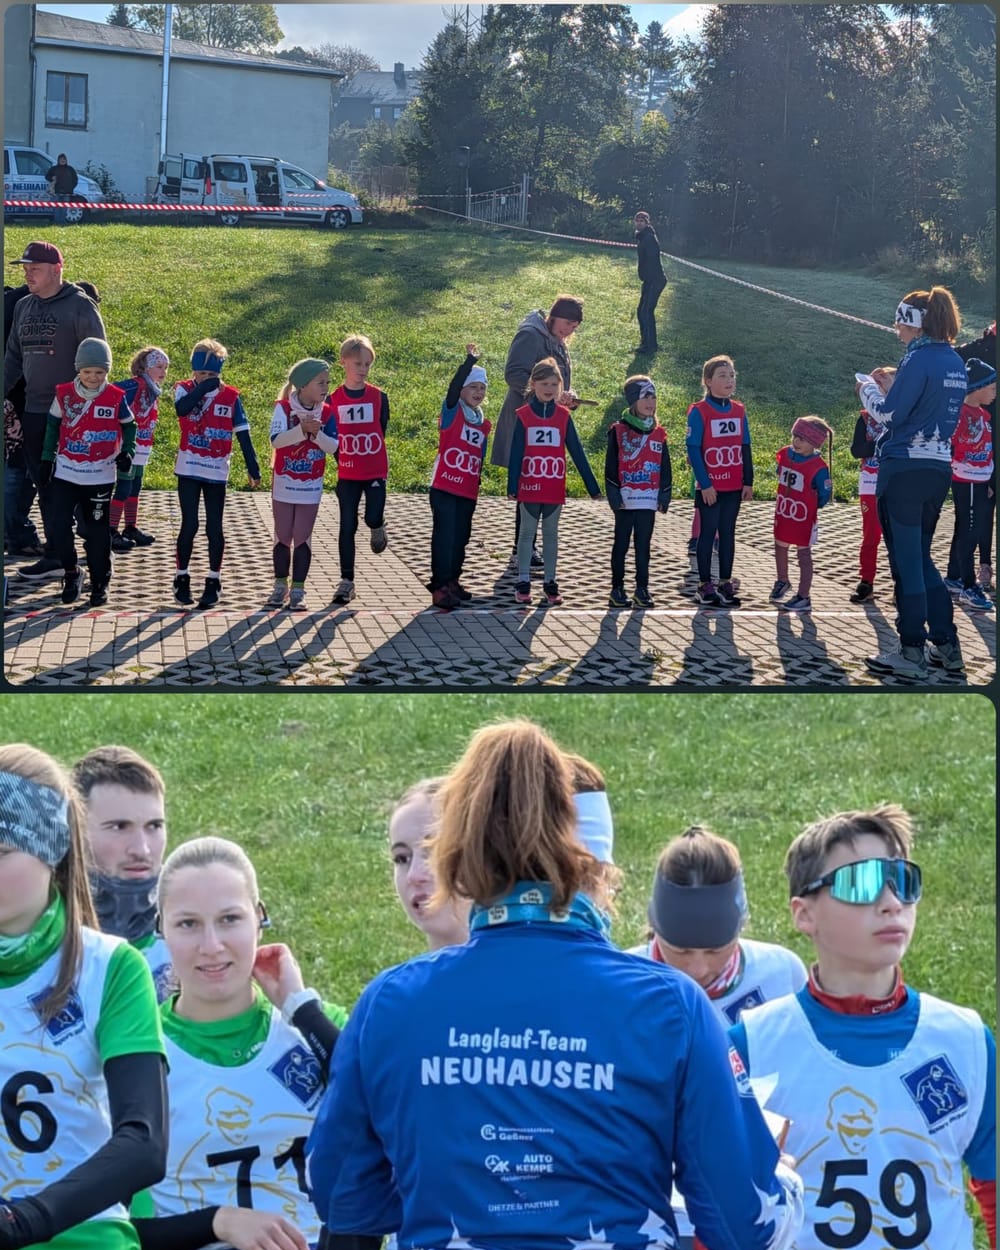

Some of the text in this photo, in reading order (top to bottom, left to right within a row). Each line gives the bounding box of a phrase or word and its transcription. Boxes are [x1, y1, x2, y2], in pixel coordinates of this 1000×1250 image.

[97, 403, 112, 417] 09
[217, 406, 229, 416] 17
[347, 406, 364, 420] 11
[718, 420, 736, 433] 20
[465, 429, 480, 444] 12
[535, 430, 553, 443] 21
[340, 460, 354, 468] udi
[441, 471, 464, 484] Audi
[708, 472, 731, 480] Audi
[448, 1027, 588, 1054] Langlauf-Team
[420, 1056, 615, 1091] NEUHAUSEN
[523, 1154, 554, 1163] AUTO
[206, 1136, 312, 1210] 71
[515, 1163, 554, 1173] KEMPE
[524, 1199, 560, 1209] PARTNER
[813, 1159, 932, 1250] 59
